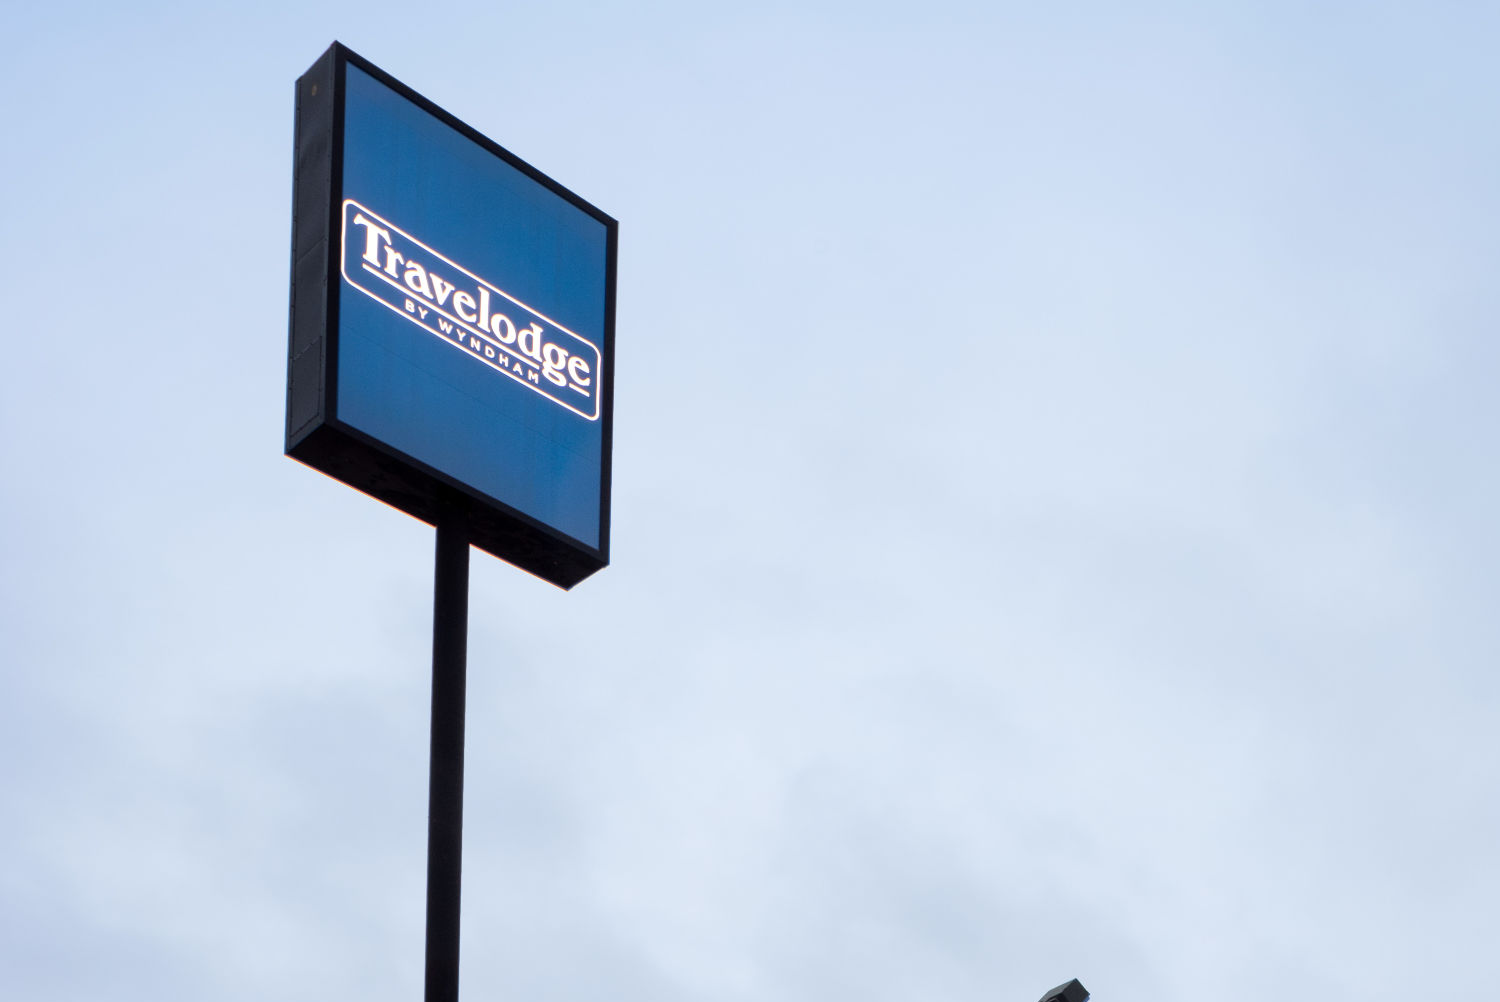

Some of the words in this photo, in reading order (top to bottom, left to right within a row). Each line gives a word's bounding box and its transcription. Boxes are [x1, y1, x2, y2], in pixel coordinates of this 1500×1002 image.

[353, 213, 591, 387] Travelodge
[404, 298, 428, 320] BY
[438, 317, 539, 384] WYNDHAM
